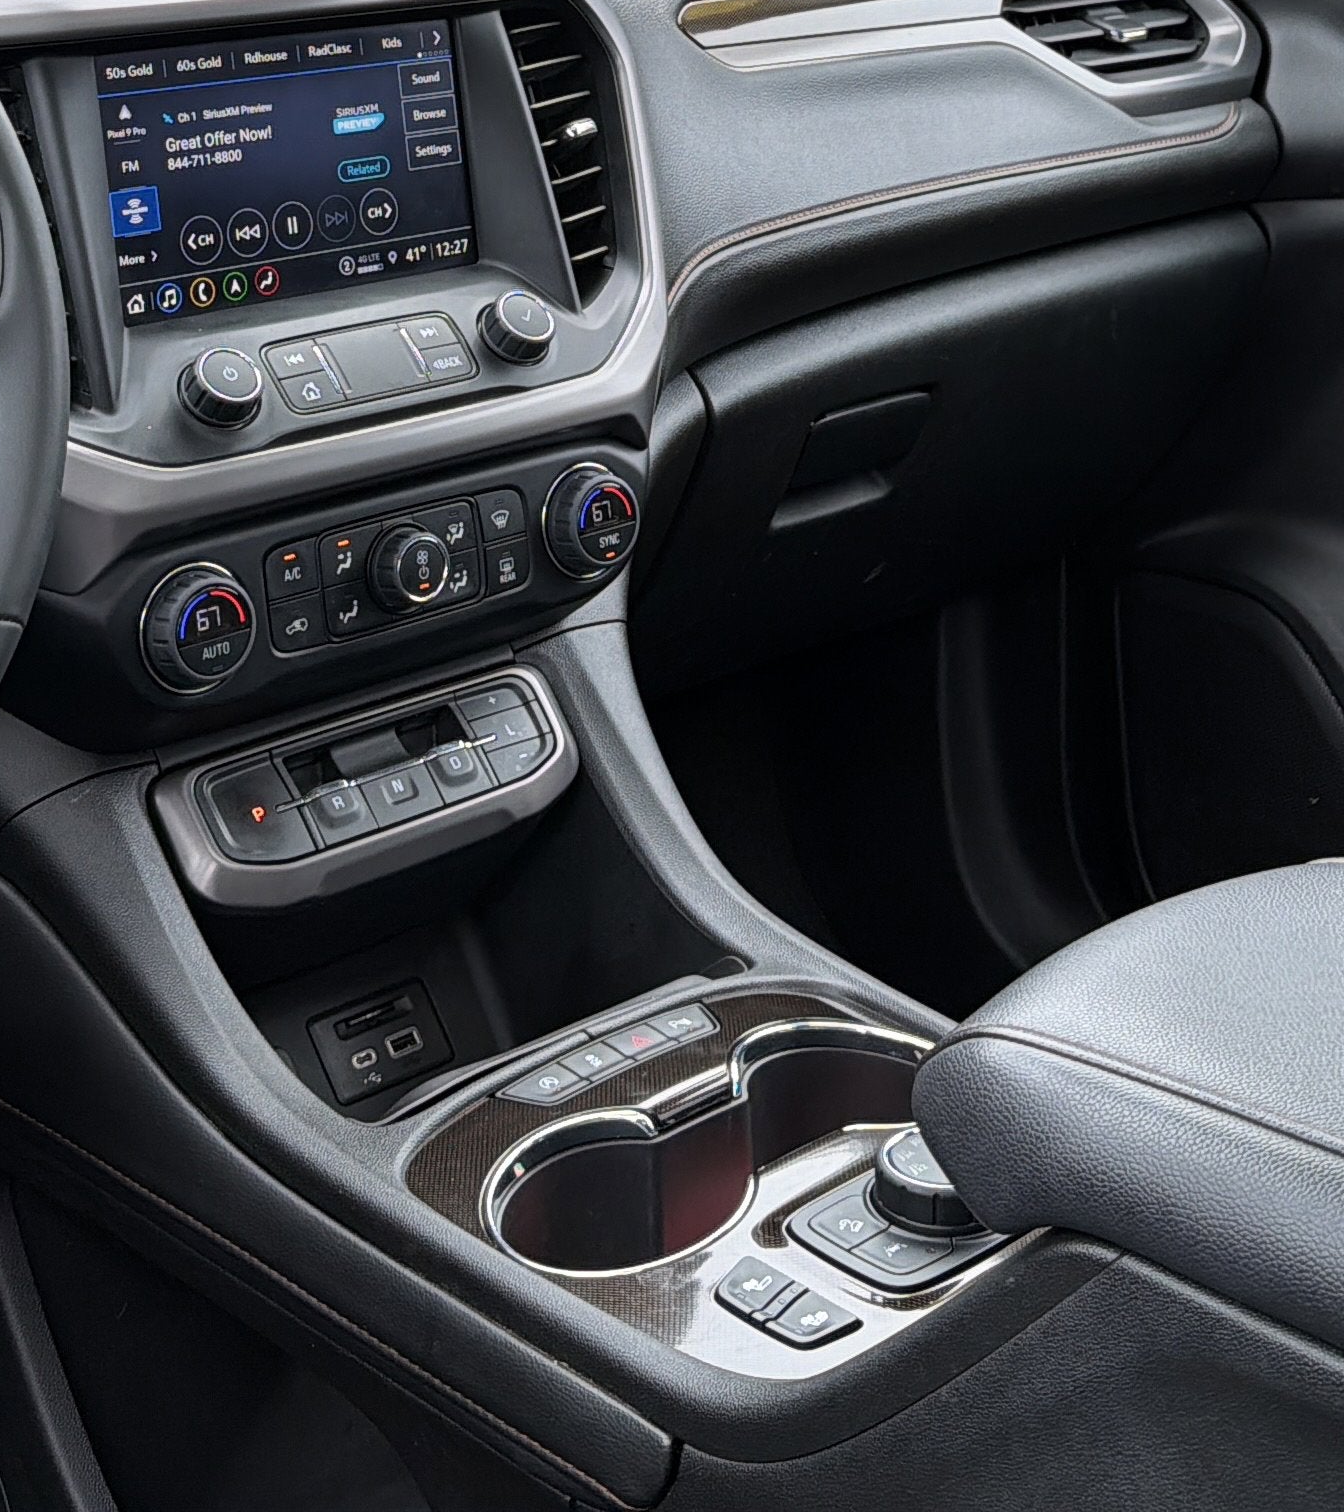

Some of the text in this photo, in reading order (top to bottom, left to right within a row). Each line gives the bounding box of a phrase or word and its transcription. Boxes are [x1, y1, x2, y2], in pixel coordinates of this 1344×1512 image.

[307, 41, 353, 57] RadClasc
[382, 36, 403, 50] Kids
[176, 55, 222, 72] 60s Gold
[244, 50, 288, 65] Rdhouse
[106, 63, 154, 80] 50s Gold
[411, 71, 441, 86] Sound
[177, 103, 273, 124] Ch 1 SiriusXM Preview
[336, 103, 379, 118] SIRIUSXM
[413, 108, 447, 122] Browse
[107, 126, 147, 140] Pixel 9 Pro
[165, 125, 273, 153] Great Offer Now!
[415, 143, 453, 158] Settings
[121, 160, 140, 174] FM
[167, 148, 243, 171] 844-711-8800
[346, 161, 382, 177] Related
[367, 206, 383, 219] CH
[197, 233, 215, 247] CH
[119, 254, 146, 267] More
[342, 260, 351, 272] 2
[368, 252, 381, 262] LTE
[405, 244, 427, 263] 41°
[435, 238, 469, 258] 12:27
[438, 356, 464, 371] BACK
[591, 500, 613, 523] 67
[599, 532, 621, 549] SYNC
[284, 566, 302, 582] A/C
[499, 571, 517, 585] REAR
[196, 605, 222, 632] 67
[202, 641, 231, 661] AUTO
[504, 723, 516, 737] L
[450, 756, 462, 770] D
[390, 778, 405, 793] N
[331, 795, 345, 810] R
[251, 805, 266, 822] P
